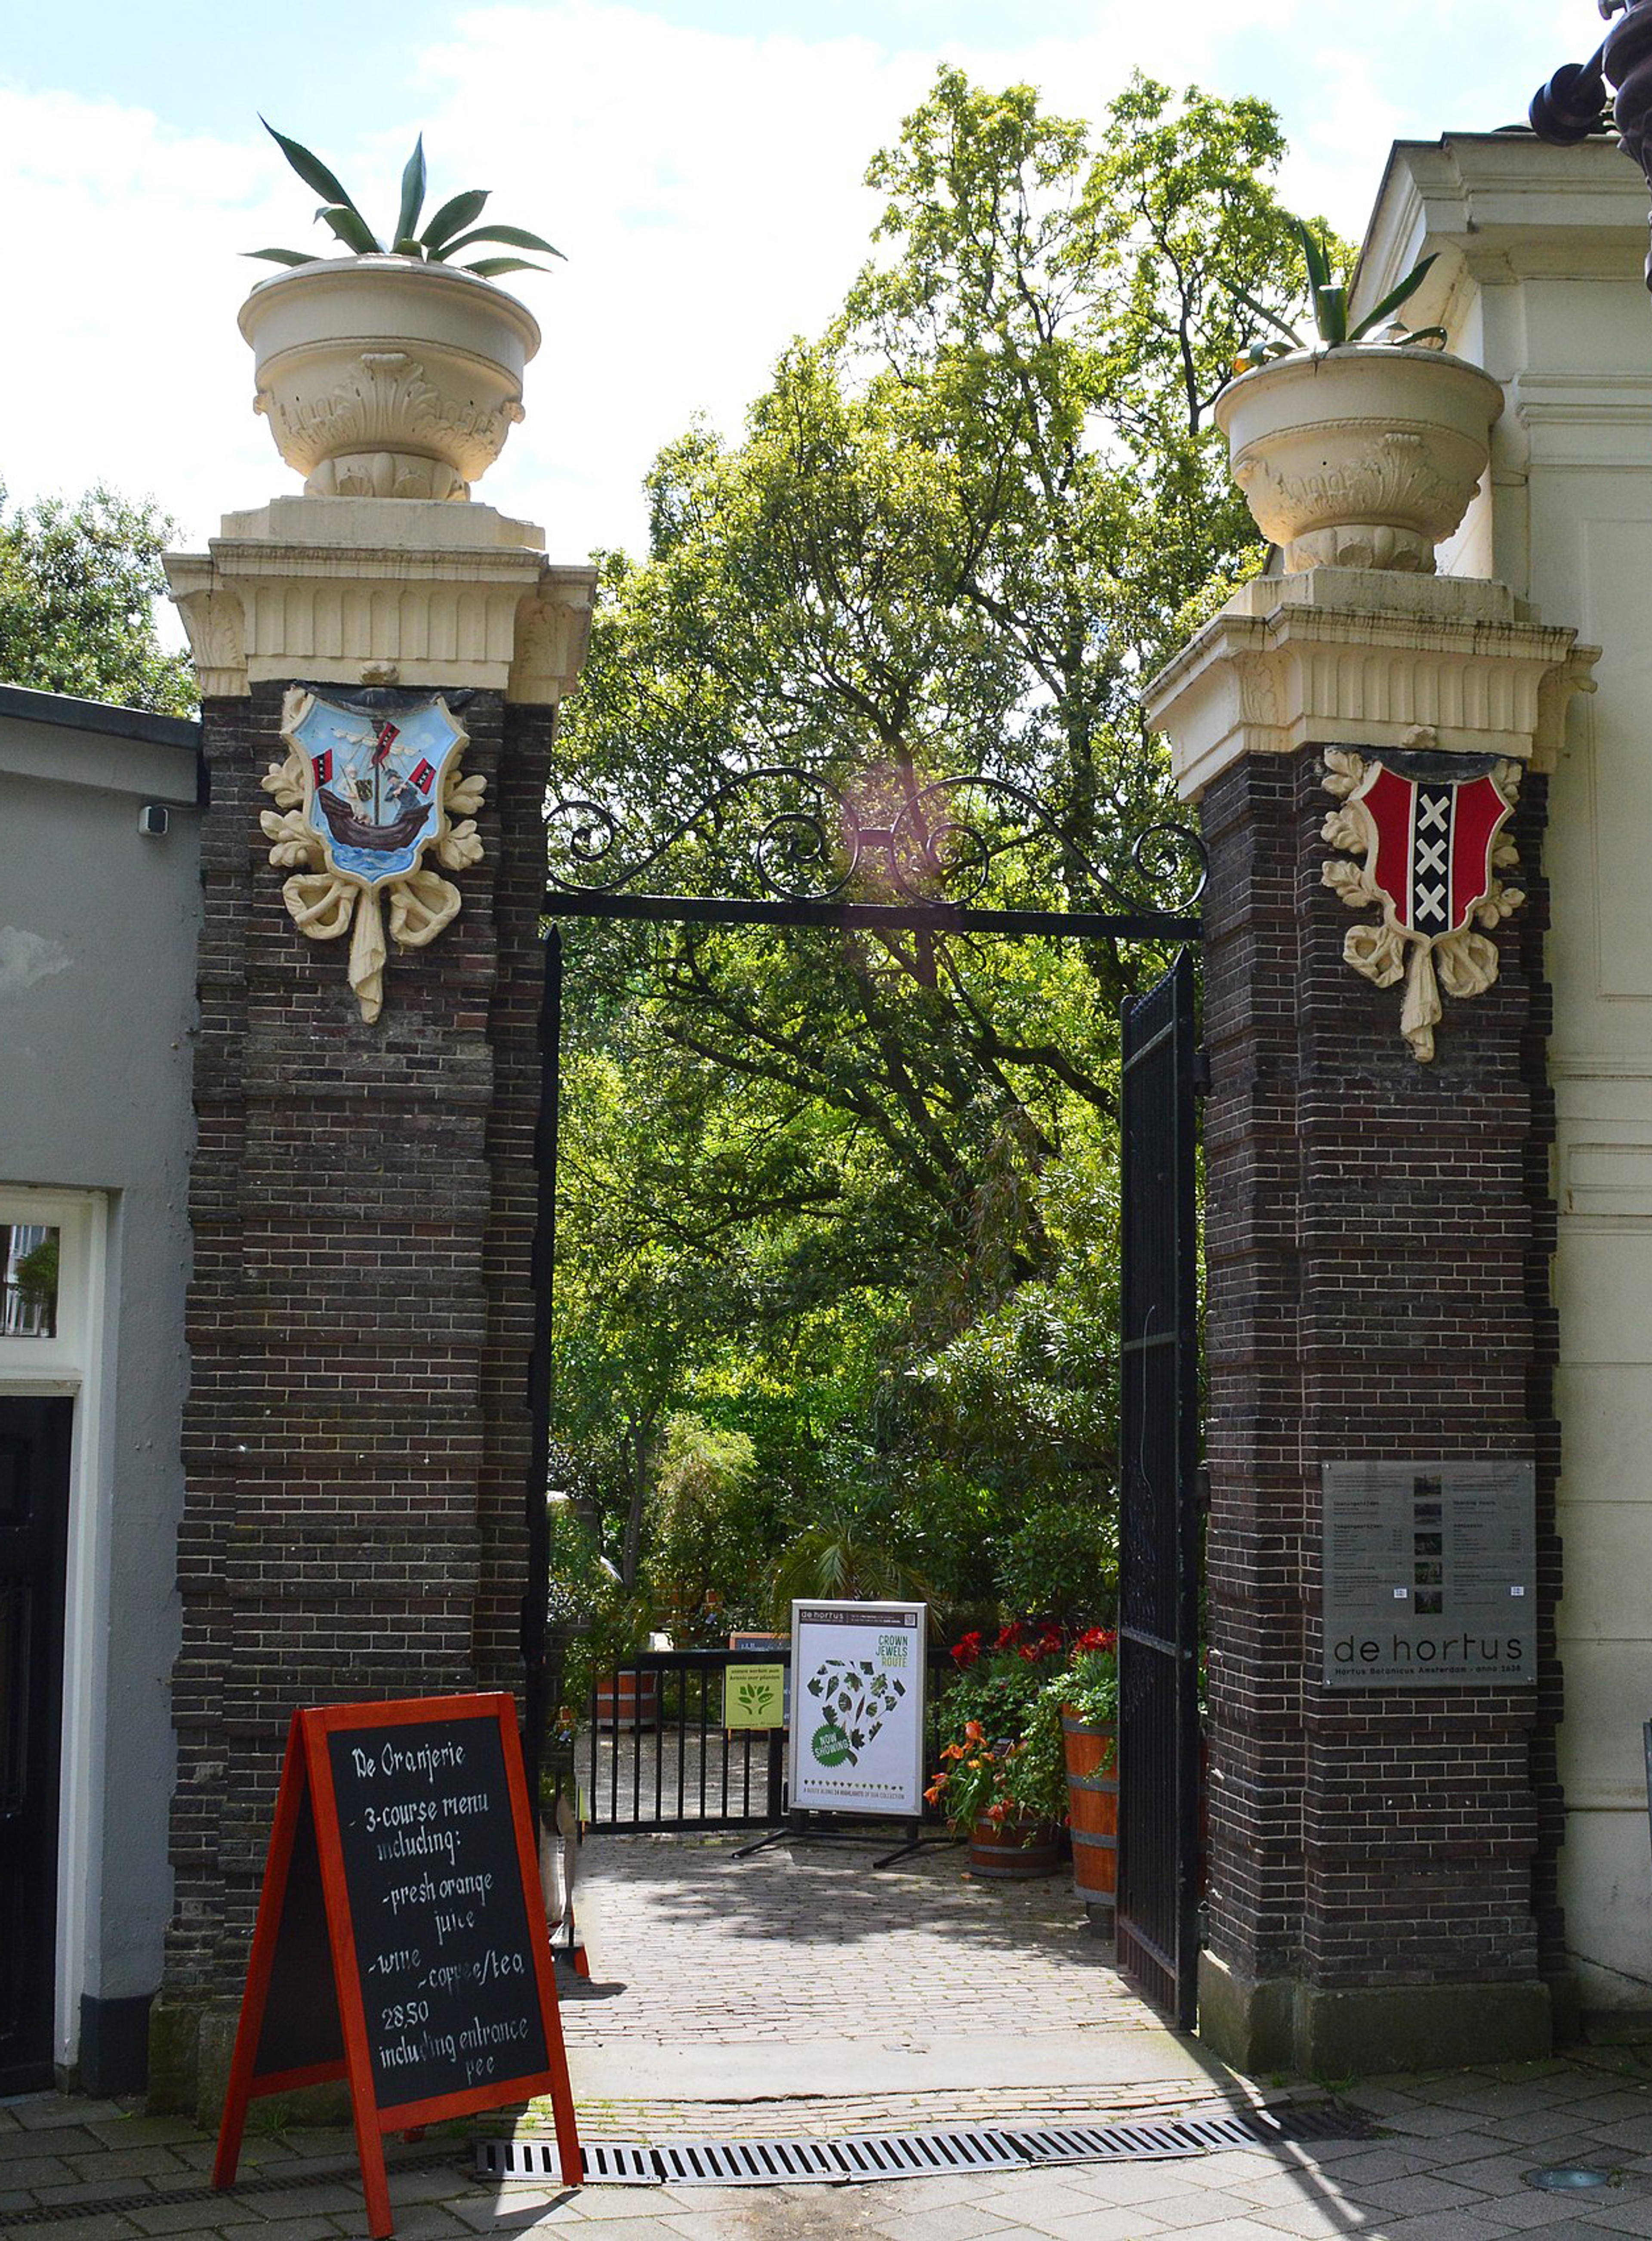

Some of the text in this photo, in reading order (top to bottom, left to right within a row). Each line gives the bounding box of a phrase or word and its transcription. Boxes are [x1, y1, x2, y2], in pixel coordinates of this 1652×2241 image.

[814, 1611, 843, 1619] hortus
[875, 1646, 908, 1657] JEWELS
[878, 1635, 908, 1646] CROWN
[1334, 1633, 1523, 1662] de hortus
[882, 1657, 907, 1667] ROUTE
[814, 1739, 848, 1757] SHOWING
[820, 1732, 837, 1744] NOW
[351, 1741, 465, 1784] De Oranjerie
[364, 1801, 438, 1833] 3-course
[442, 1793, 489, 1817] menu
[377, 1825, 461, 1866] including:
[439, 1873, 493, 1907] orange
[434, 1908, 475, 1946] juice
[379, 2016, 530, 2068] including entrance
